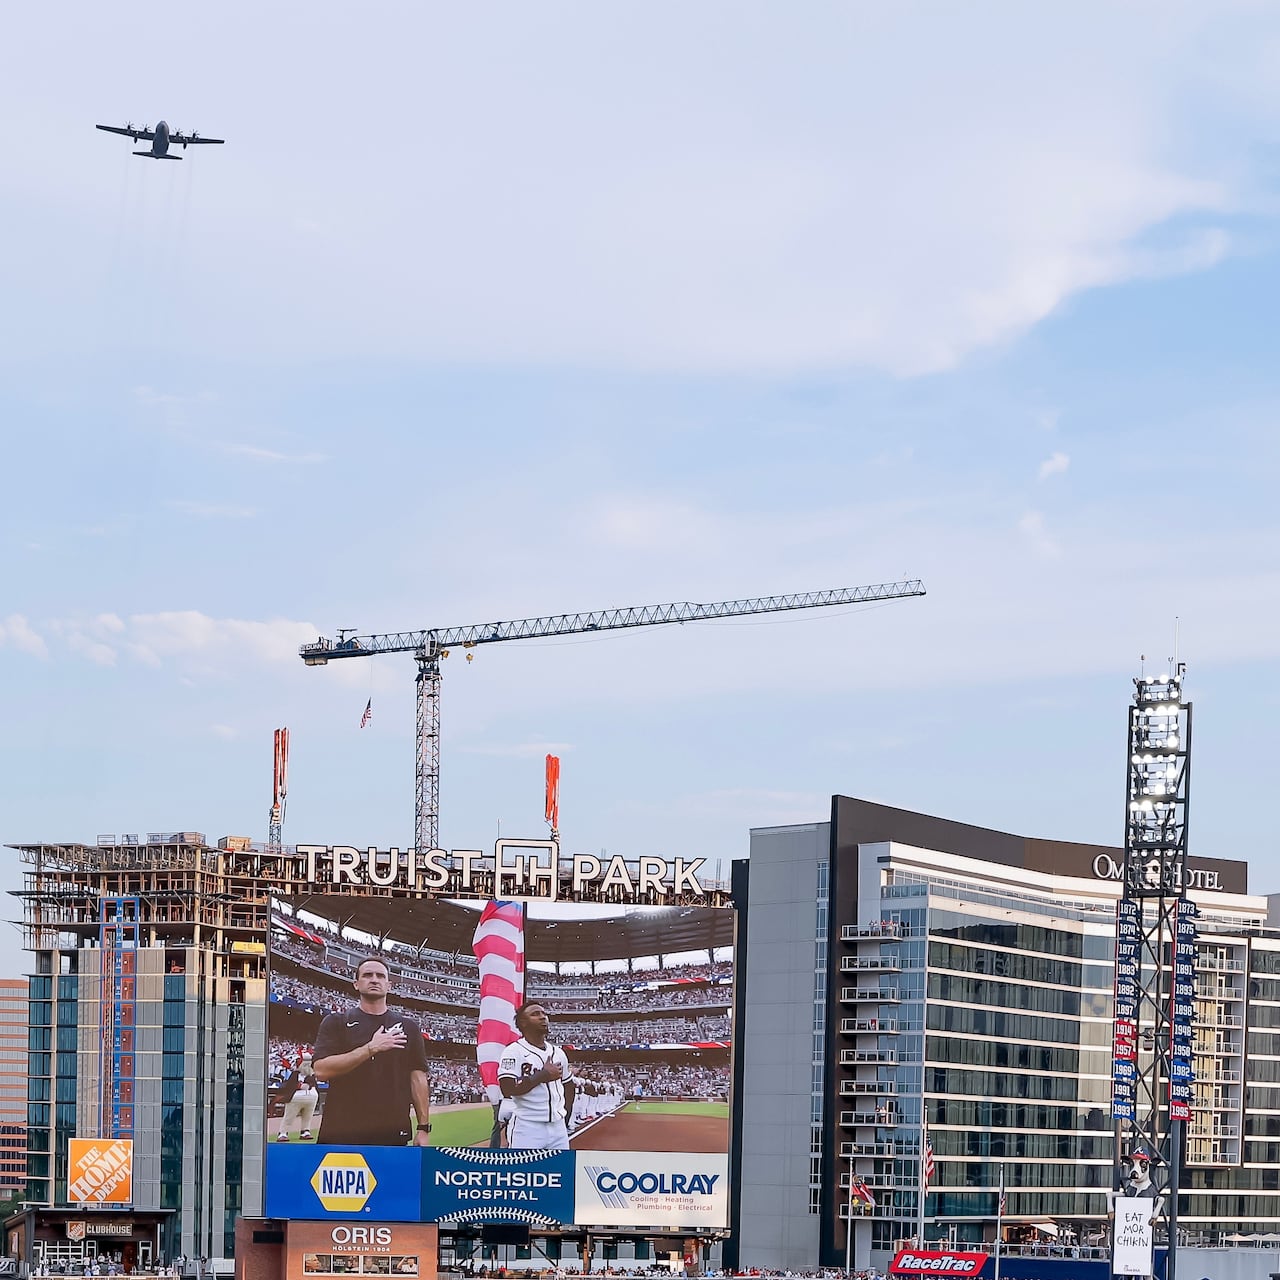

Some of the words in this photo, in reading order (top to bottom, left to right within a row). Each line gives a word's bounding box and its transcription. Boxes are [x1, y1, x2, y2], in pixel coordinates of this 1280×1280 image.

[296, 844, 483, 888] TRUIST
[573, 854, 707, 895] PARK
[1120, 903, 1136, 915] 1872
[1120, 923, 1136, 935] 1874
[1178, 923, 1194, 935] 1875
[1176, 964, 1193, 975] 1891
[1176, 984, 1193, 995] 1893
[1115, 1064, 1132, 1076] 1969
[1173, 1065, 1190, 1077] 1982
[1173, 1085, 1189, 1097] 1992
[1114, 1104, 1130, 1116] 1993
[1172, 1105, 1188, 1117] 1995
[76, 1146, 102, 1172] THE
[70, 1141, 132, 1201] HOME
[93, 1163, 132, 1201] DEPOT
[322, 1170, 367, 1196] NAPA
[434, 1170, 562, 1189] NORTHSIDE
[596, 1172, 720, 1194] COOLRAY
[458, 1190, 539, 1201] HOSPITAL
[665, 1196, 694, 1204] Heating
[637, 1204, 672, 1212] Plumbing
[1126, 1212, 1144, 1222] EAT
[86, 1224, 131, 1234] CLUBHOUSE
[1124, 1224, 1144, 1234] MOR
[331, 1226, 392, 1245] ORIS
[1117, 1236, 1148, 1247] CHIKIN
[898, 1254, 976, 1272] RaceTrac
